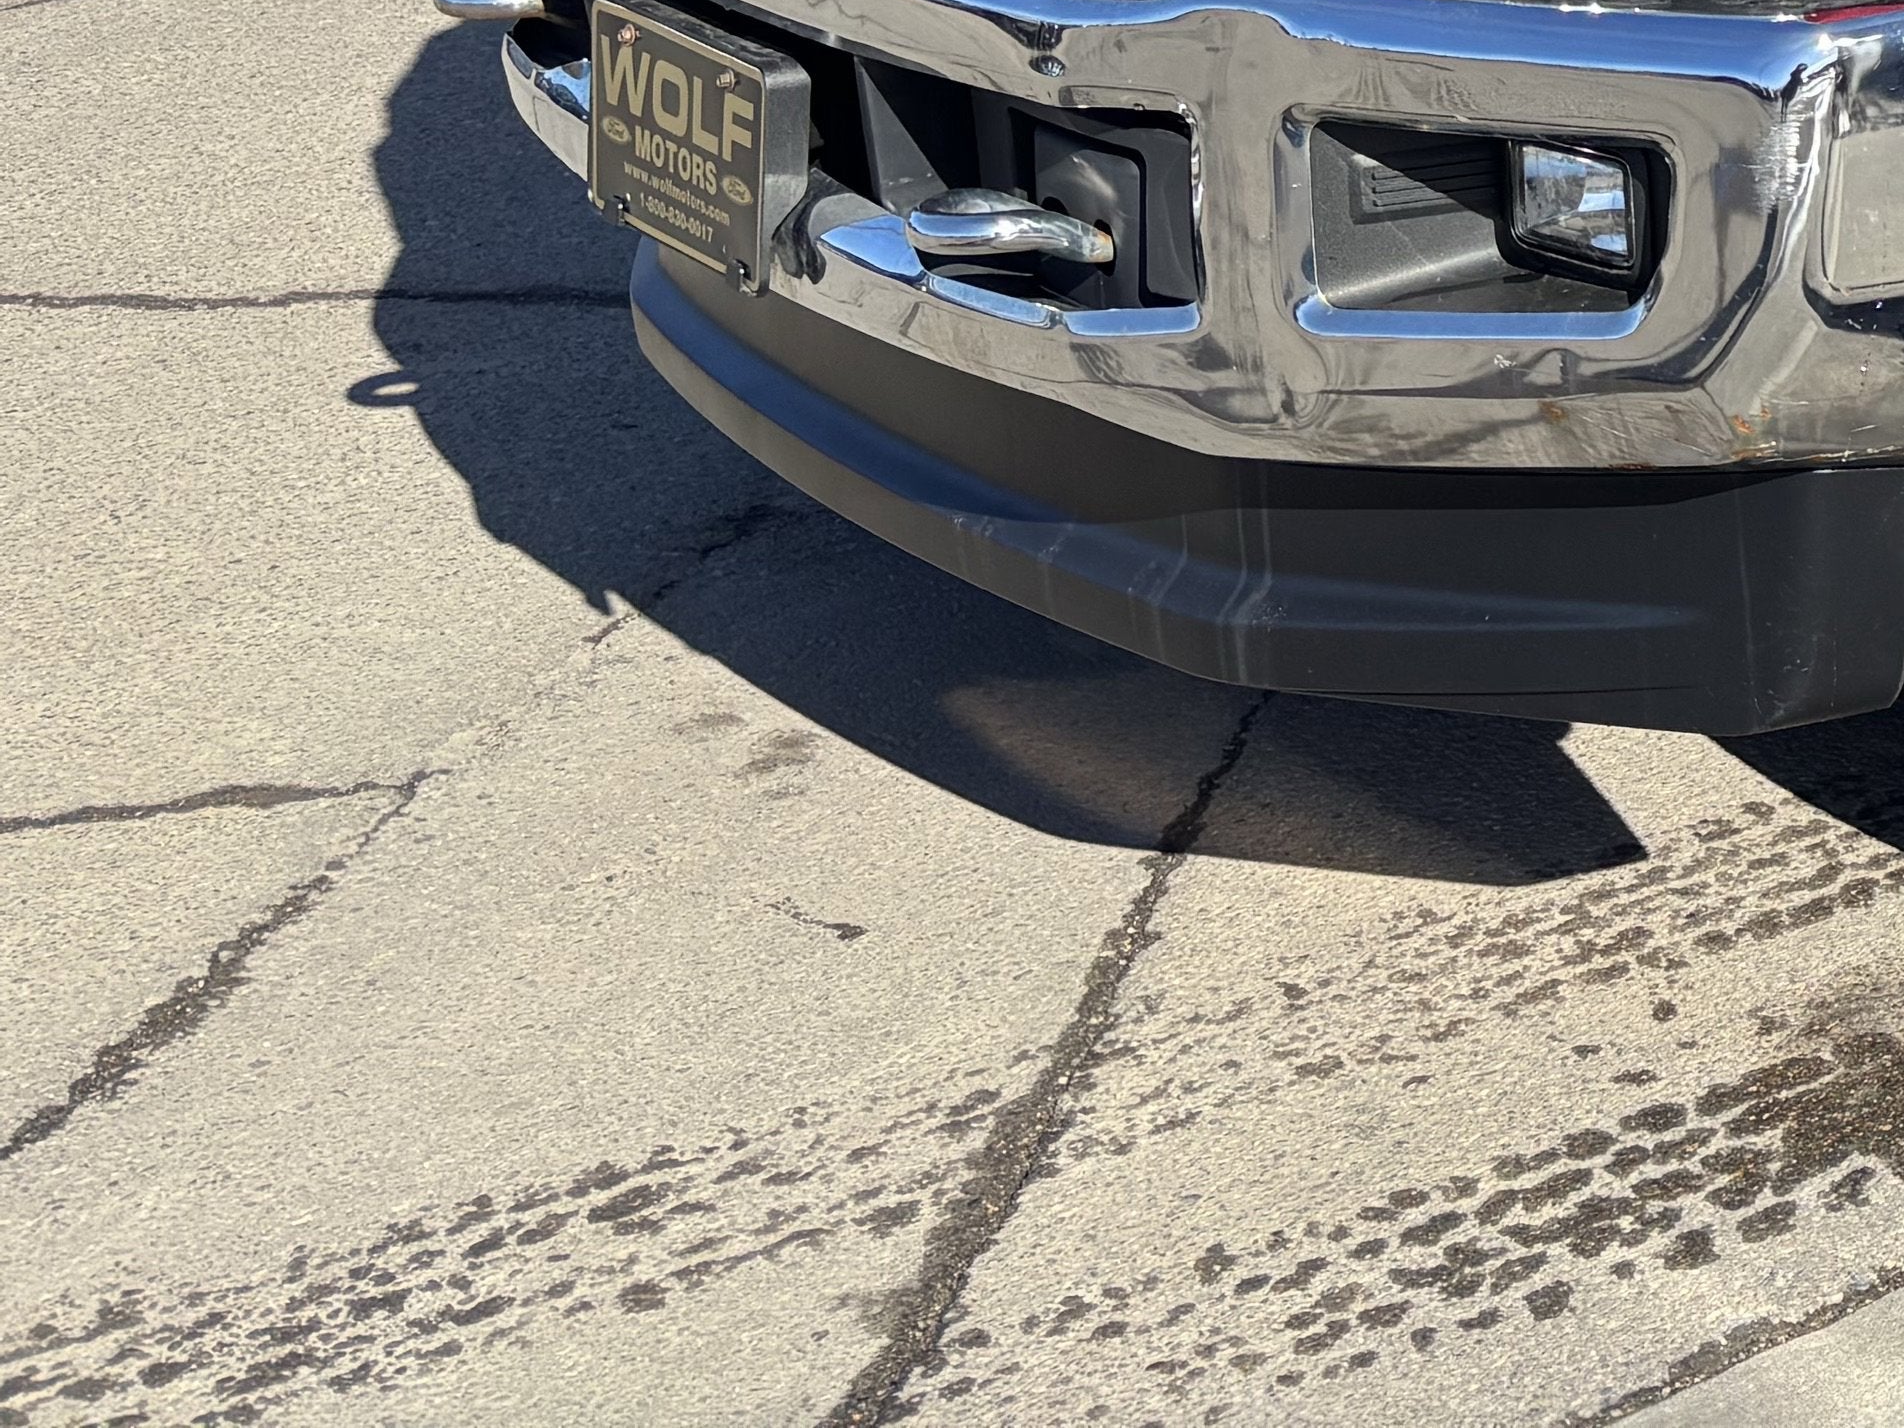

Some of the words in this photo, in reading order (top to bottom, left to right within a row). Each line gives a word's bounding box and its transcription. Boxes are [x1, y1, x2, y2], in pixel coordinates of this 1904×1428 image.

[601, 34, 754, 163] WOLF
[623, 161, 731, 227] www.wolfmotors.com
[635, 125, 718, 196] MOTORS
